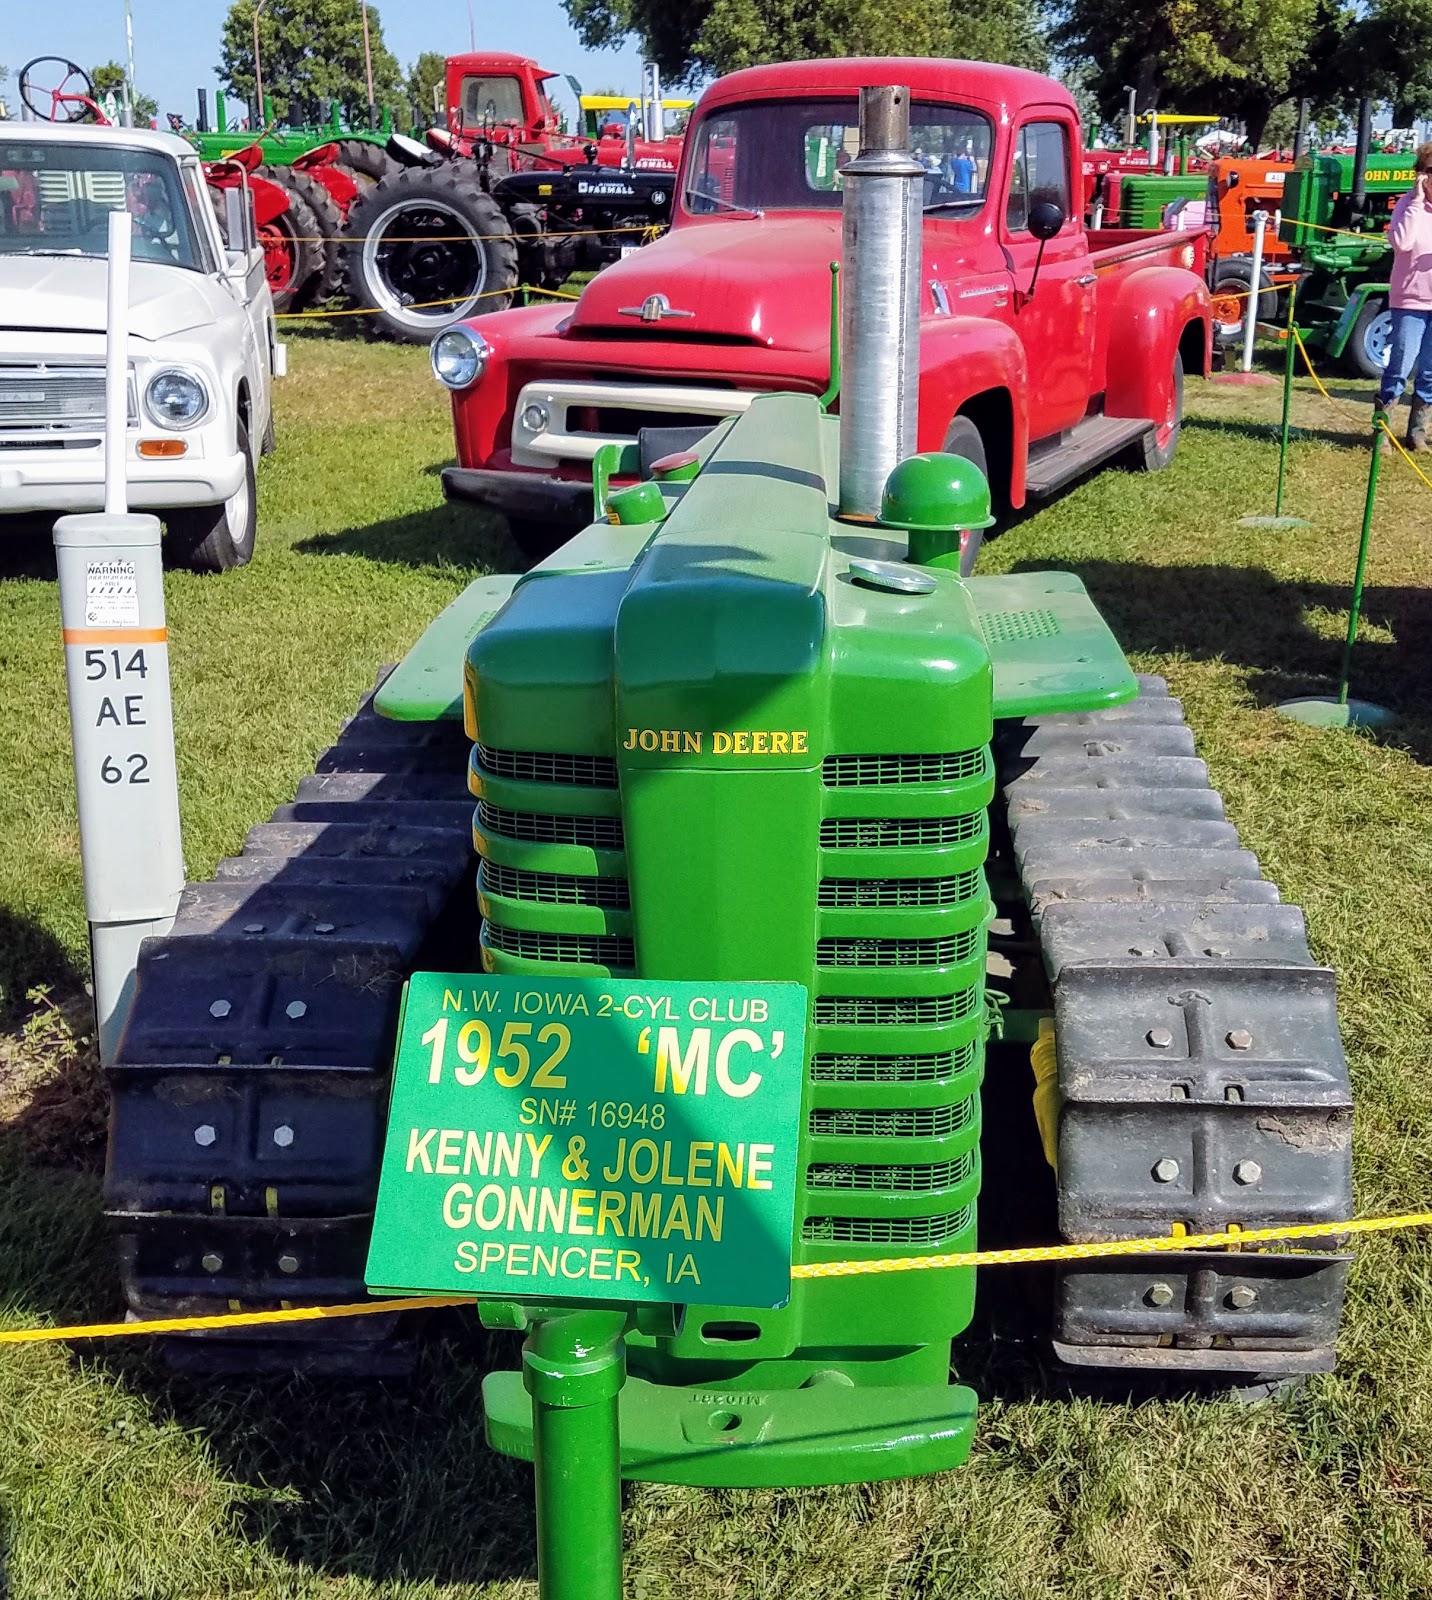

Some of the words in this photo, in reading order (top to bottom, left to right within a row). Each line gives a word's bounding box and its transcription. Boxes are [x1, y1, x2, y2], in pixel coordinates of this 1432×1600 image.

[588, 184, 635, 195] FARMALL
[1365, 170, 1391, 181] OHN
[1393, 170, 1416, 181] DEE
[87, 566, 135, 575] WARNING
[85, 648, 148, 681] 514
[95, 695, 147, 727] AE
[622, 728, 703, 755] JOHN
[712, 730, 809, 755] DEERE
[100, 753, 150, 784] 62
[442, 989, 503, 1014] N.W.
[513, 991, 590, 1017] IOWA
[596, 994, 681, 1020] 2-CYL
[688, 996, 769, 1023] CLUB
[420, 1017, 572, 1090] 1952
[518, 1097, 577, 1126] SN#
[586, 1100, 666, 1131] 16948
[405, 1128, 553, 1179] KENNY
[561, 1135, 590, 1182] &
[603, 1137, 775, 1191] JOLENE
[442, 1182, 725, 1243] GONNERMAN
[453, 1241, 651, 1288] SPENCER,
[666, 1252, 702, 1285] IA
